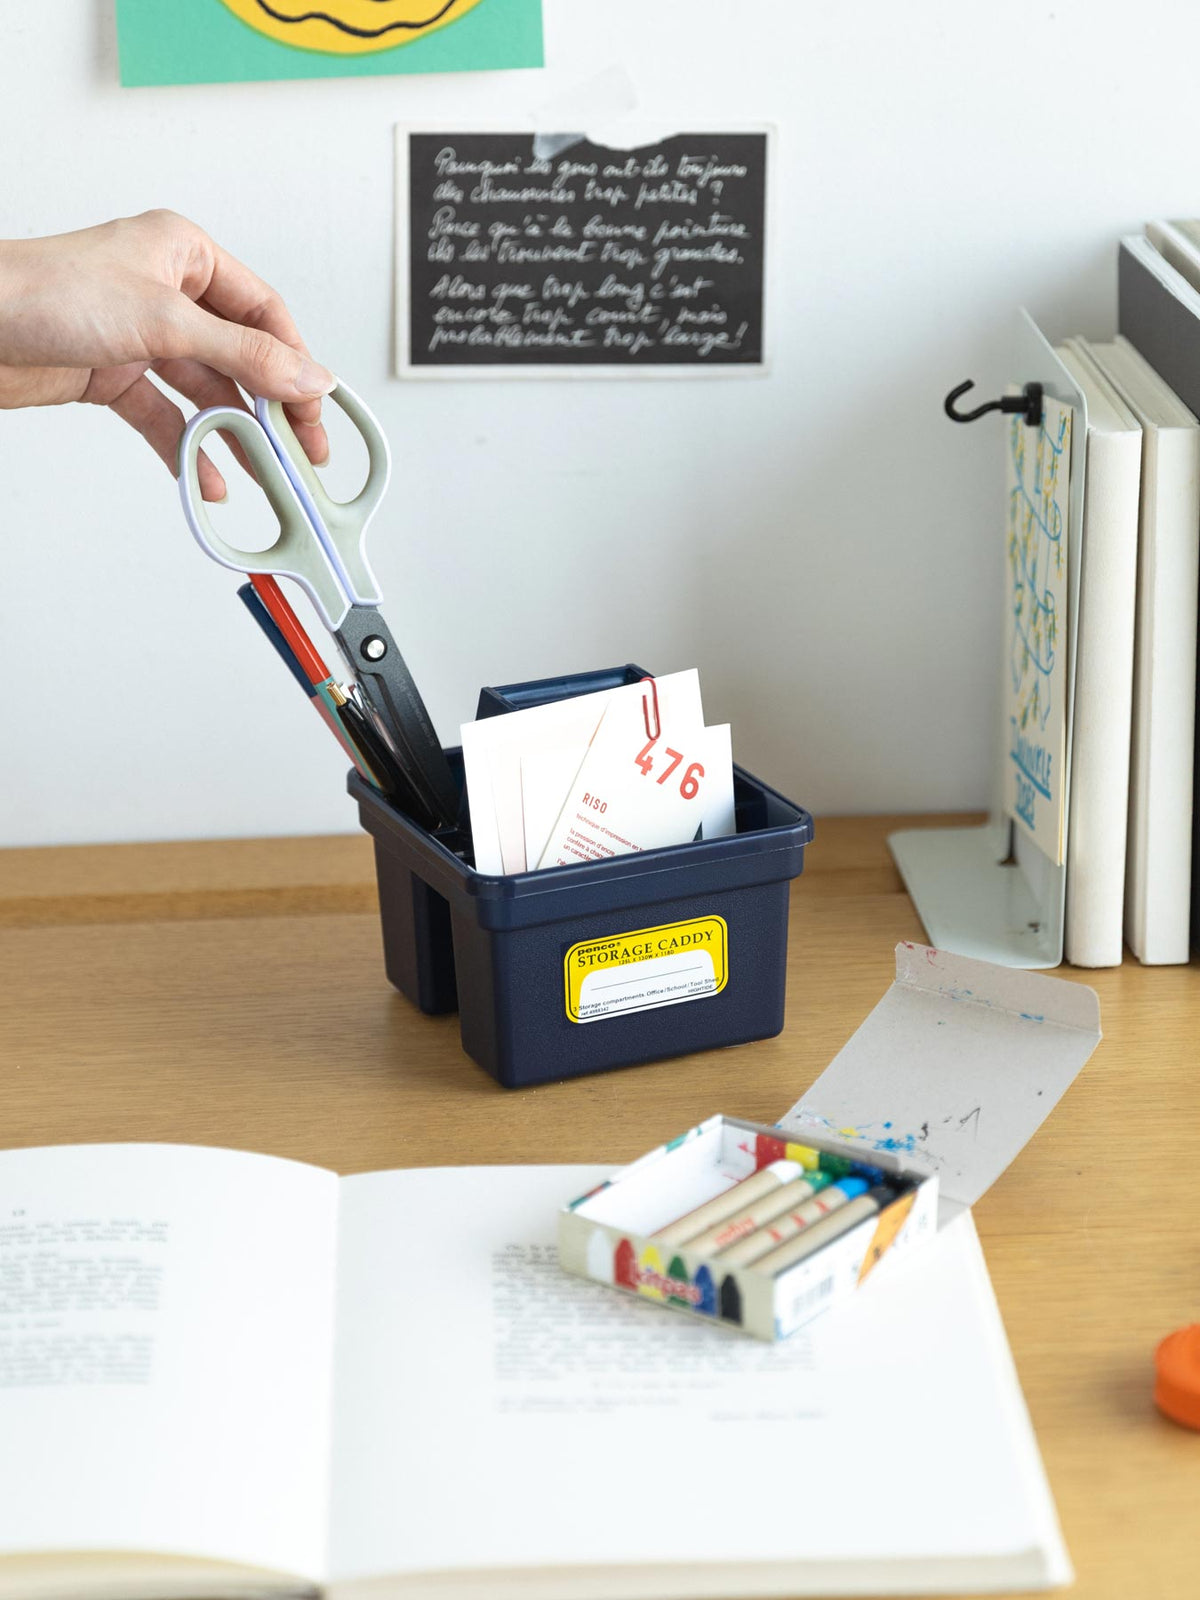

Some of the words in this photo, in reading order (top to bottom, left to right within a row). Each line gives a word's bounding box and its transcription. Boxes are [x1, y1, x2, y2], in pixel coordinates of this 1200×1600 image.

[634, 739, 706, 800] 476
[582, 792, 608, 814] RISO
[578, 943, 653, 968] STORAGE
[657, 930, 713, 951] CADDY
[579, 1001, 602, 1011] Storage
